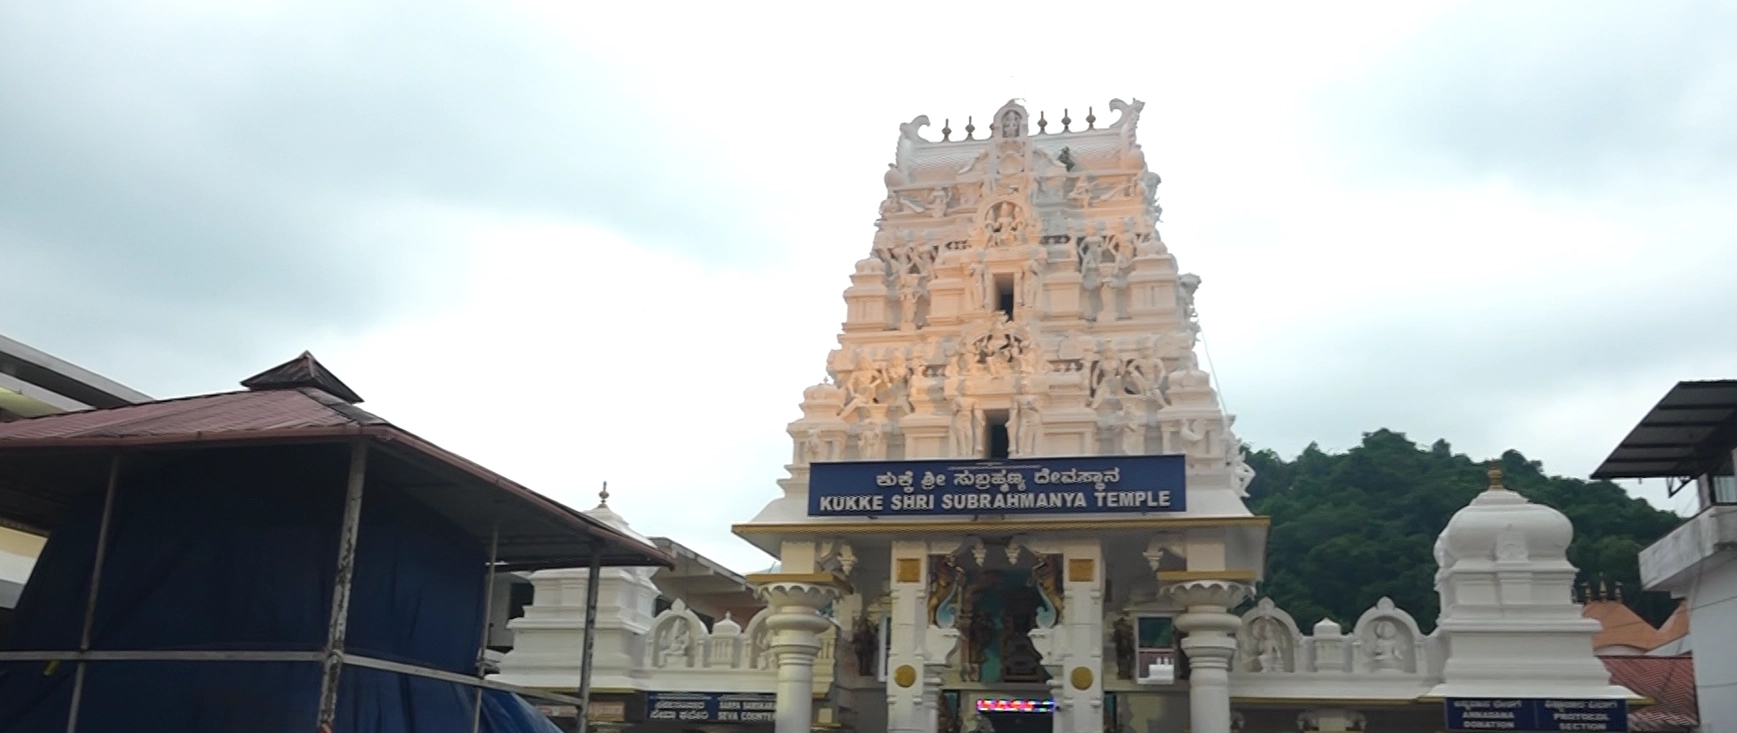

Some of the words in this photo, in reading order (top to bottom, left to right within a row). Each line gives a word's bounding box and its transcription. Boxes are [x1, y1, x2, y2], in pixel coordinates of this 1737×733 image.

[921, 470, 946, 490] ಶ್ರೀ
[1034, 467, 1120, 491] ದೇವಸ್ಥಾನ
[820, 495, 883, 512] KUKKE
[890, 494, 934, 511] SHRI
[941, 492, 1087, 510] SUBRAHMANYA
[1095, 491, 1171, 508] TEMPLE
[717, 711, 738, 720] SEVA
[1559, 722, 1607, 731] SECTION
